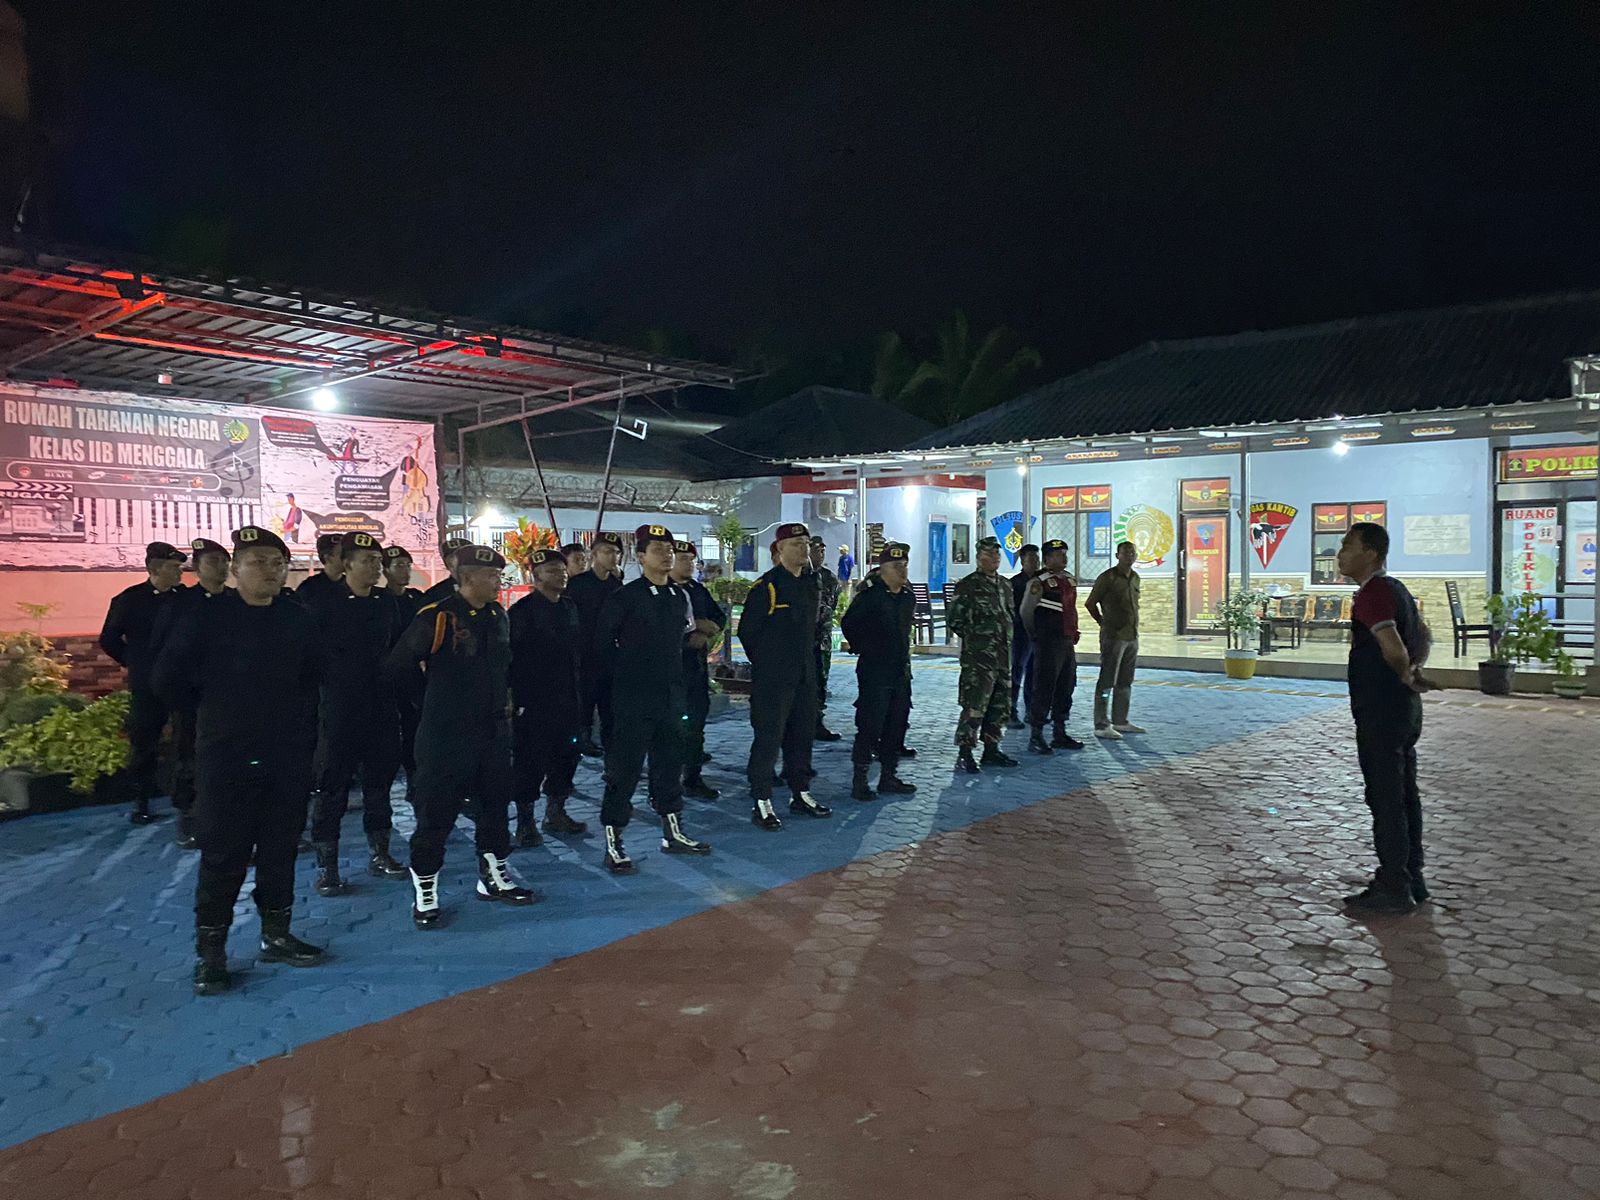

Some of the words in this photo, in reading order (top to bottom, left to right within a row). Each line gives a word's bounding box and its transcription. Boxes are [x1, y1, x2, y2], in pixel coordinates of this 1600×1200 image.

[4, 399, 73, 429] RUMAH
[75, 407, 155, 436] TAHANAN
[158, 415, 221, 441] NEGARA
[29, 435, 85, 462] KELAS
[88, 440, 114, 464] IIB
[117, 442, 206, 470] MENGGALA
[1250, 503, 1265, 513] GAS
[1505, 508, 1556, 520] RUANG
[1522, 522, 1535, 592] POLIKLI
